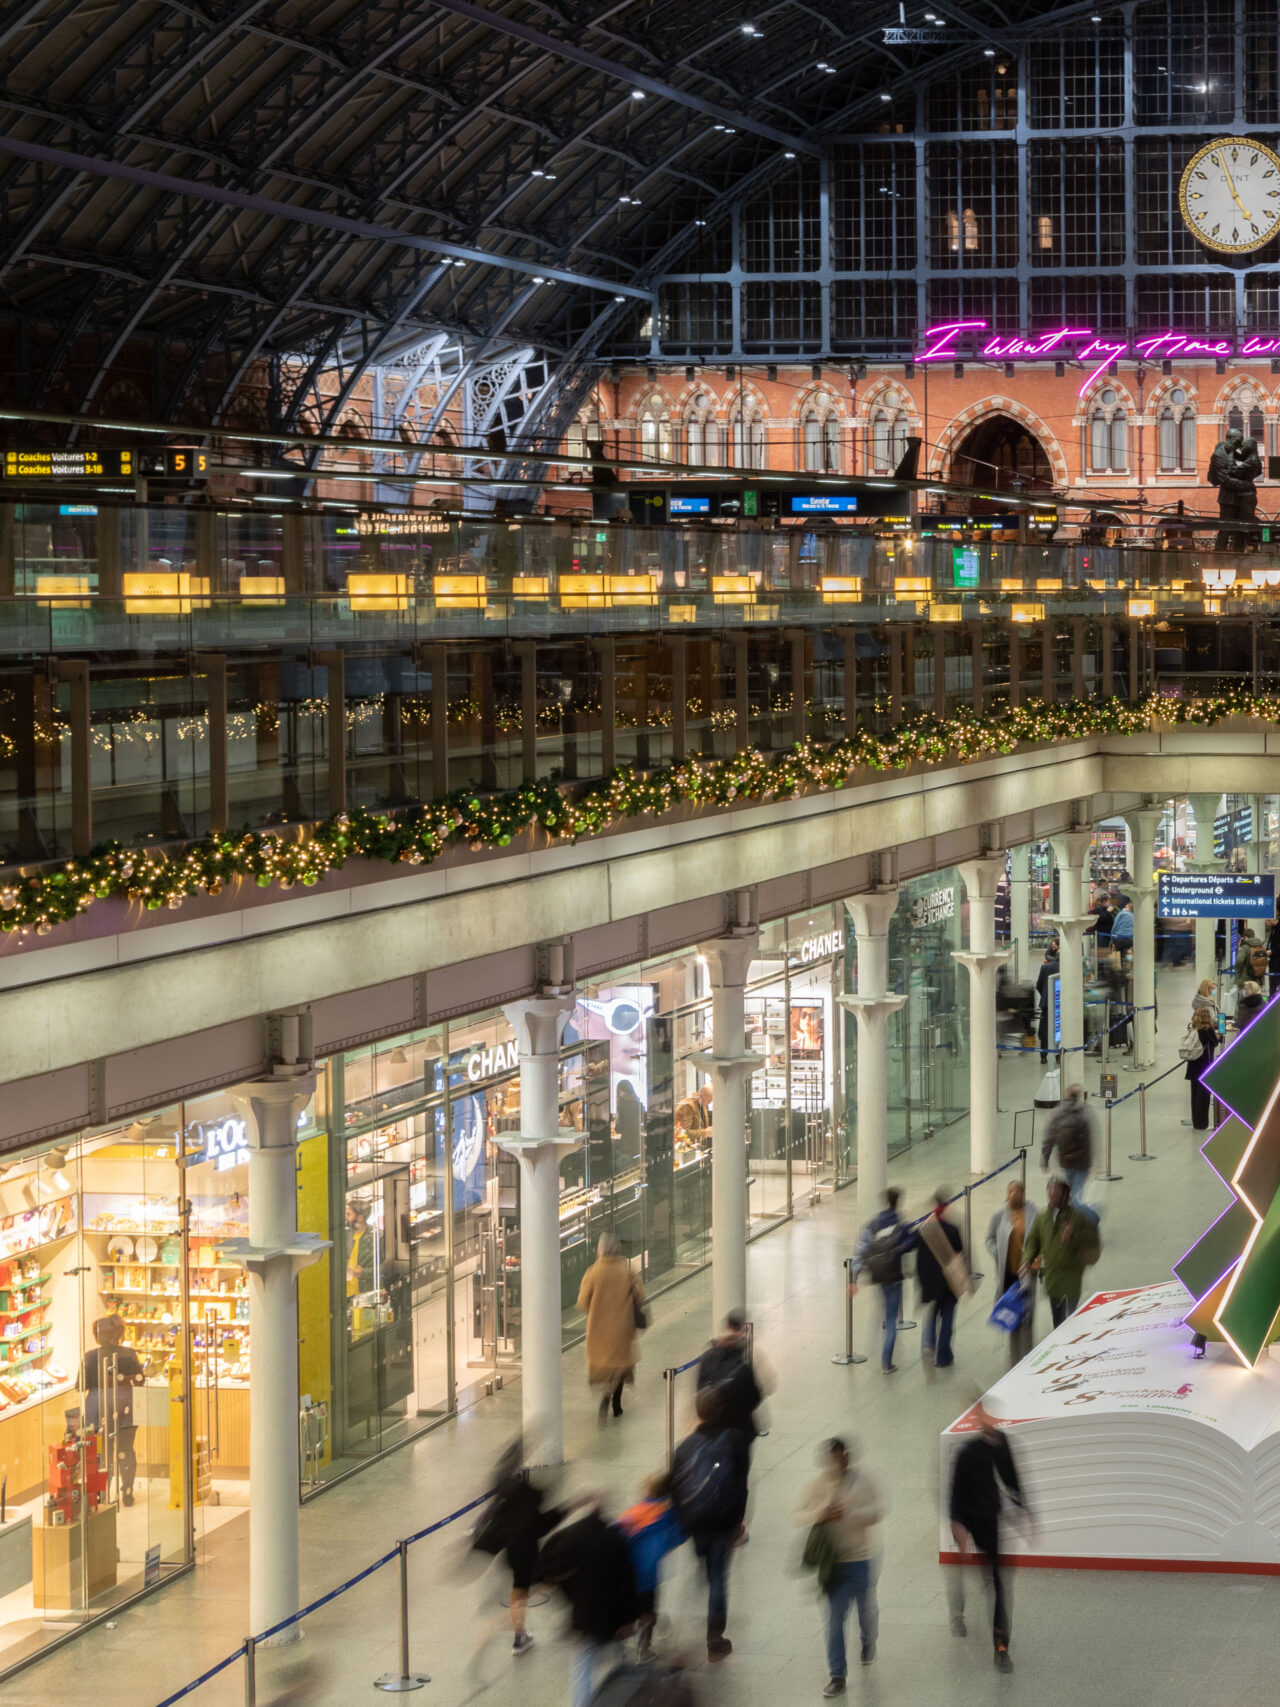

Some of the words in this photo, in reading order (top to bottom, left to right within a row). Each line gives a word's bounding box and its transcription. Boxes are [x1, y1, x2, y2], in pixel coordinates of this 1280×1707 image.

[915, 322, 986, 362] I
[984, 326, 1091, 356] want
[18, 452, 50, 462] Coaches
[51, 452, 84, 462] Voitures
[85, 452, 98, 462] 1-2
[174, 454, 186, 471] 5
[198, 455, 206, 471] 5
[18, 464, 50, 475] Coaches
[51, 464, 84, 475] Voitures
[1171, 876, 1208, 884] Departures
[1208, 875, 1234, 884] Départs
[923, 887, 955, 910] CURRENCY
[1171, 887, 1214, 895] Underground
[923, 902, 955, 925] EXCHANGE
[801, 930, 845, 963] CHANEL
[467, 1039, 519, 1081] CHAN
[1063, 1328, 1116, 1346] 11
[1063, 1390, 1105, 1406] 8
